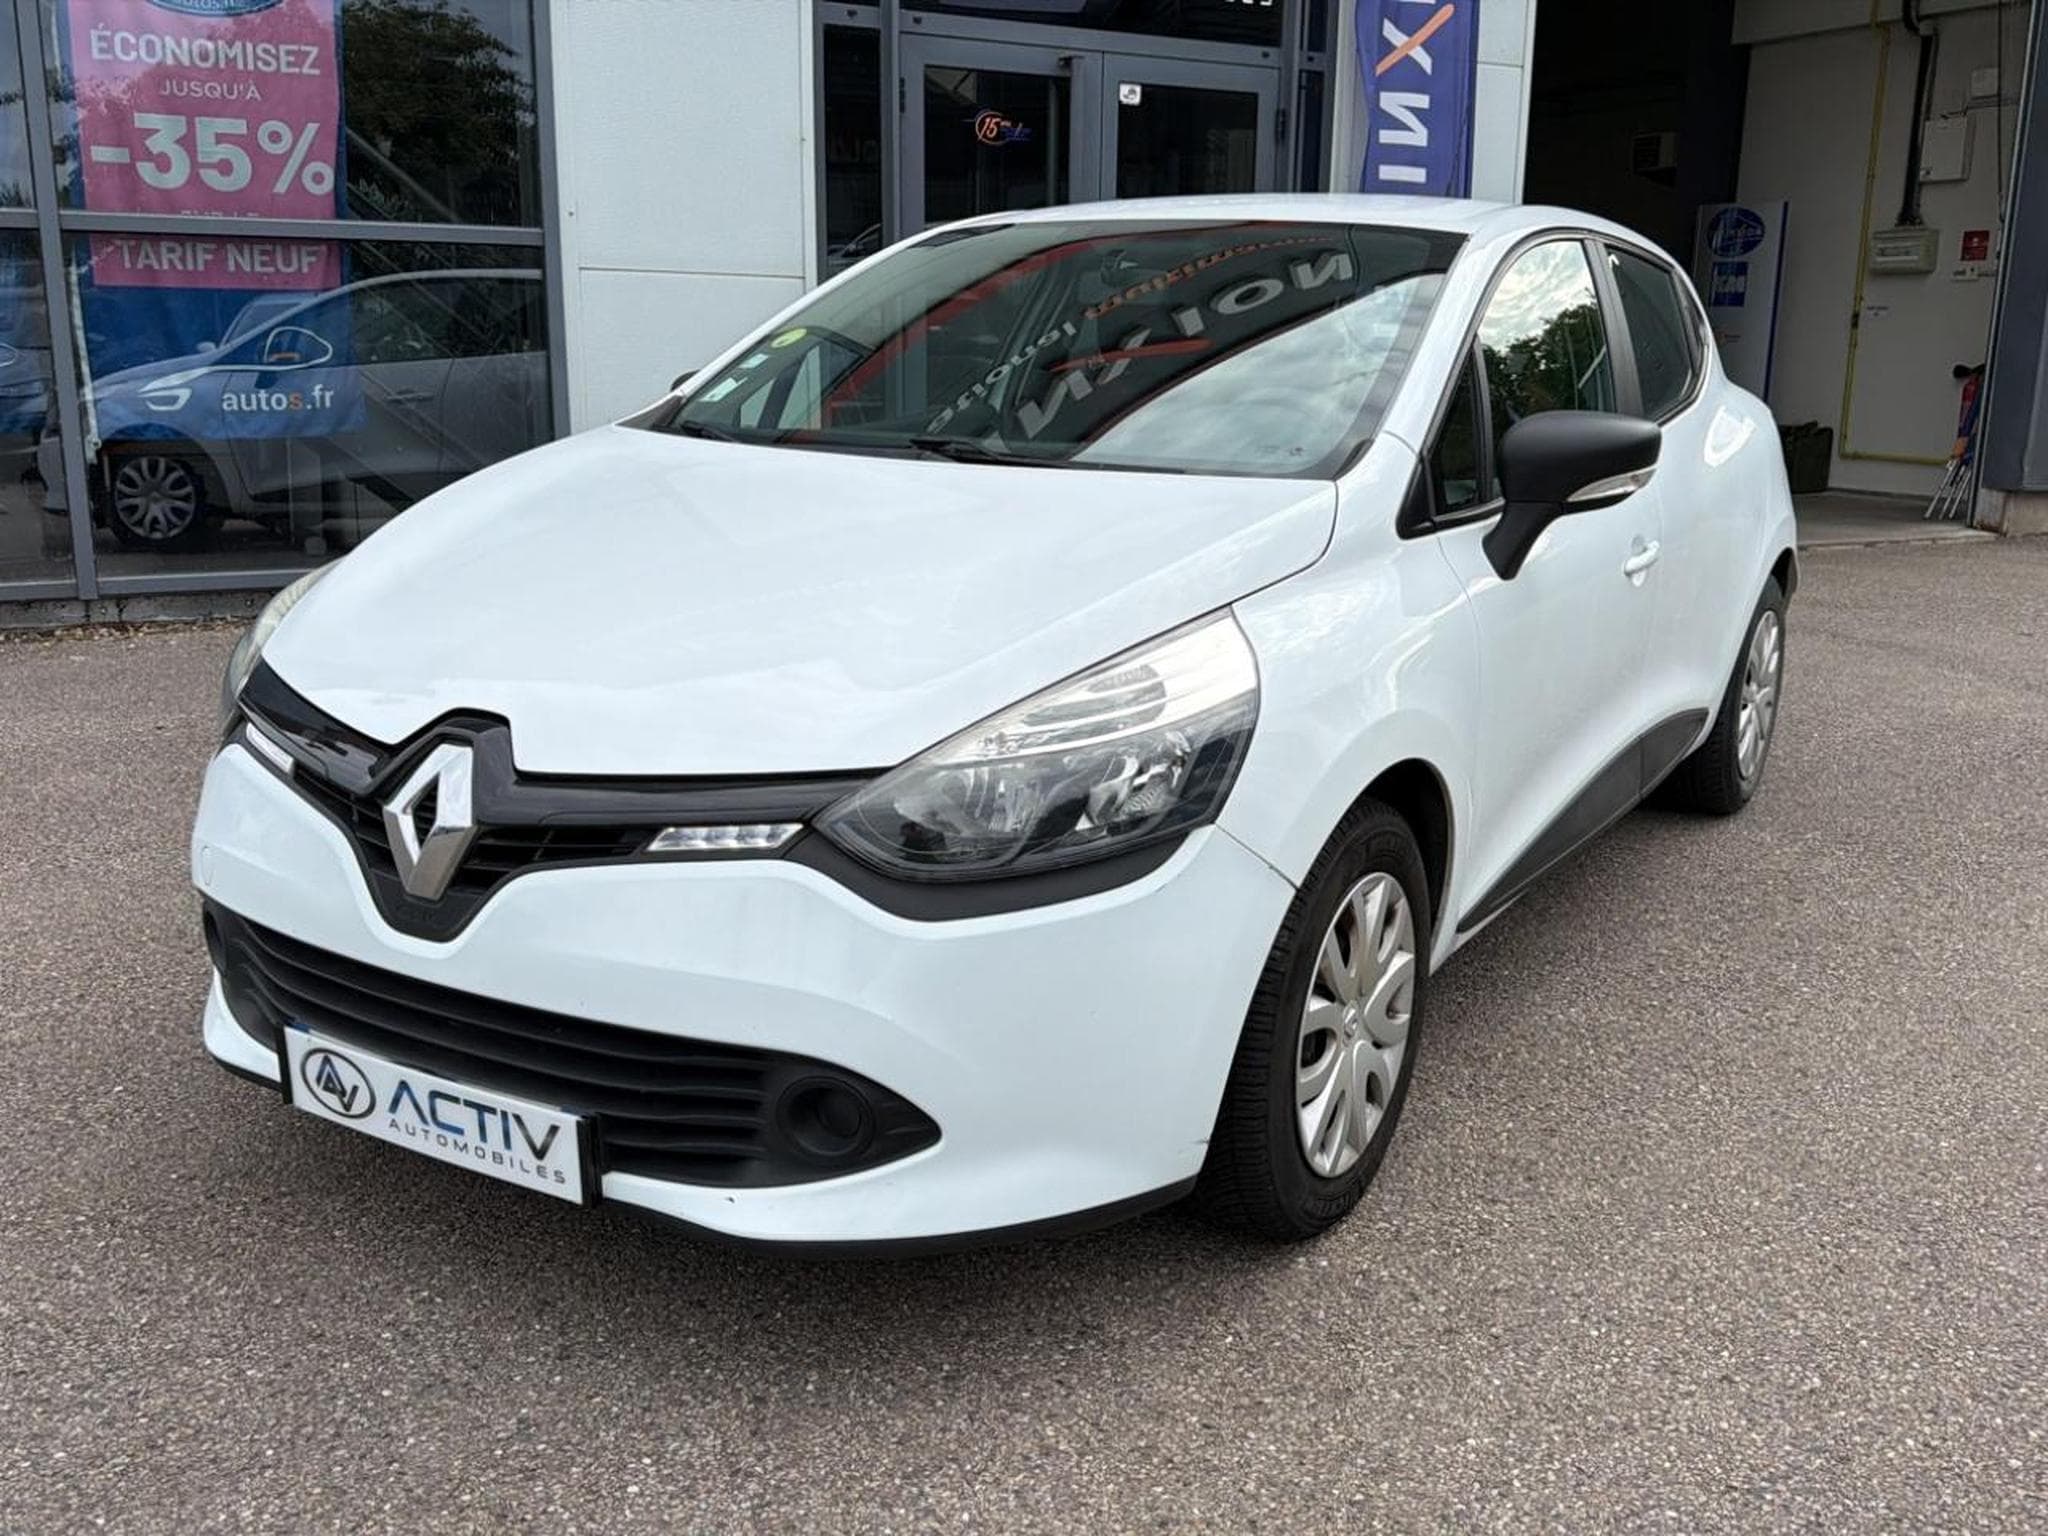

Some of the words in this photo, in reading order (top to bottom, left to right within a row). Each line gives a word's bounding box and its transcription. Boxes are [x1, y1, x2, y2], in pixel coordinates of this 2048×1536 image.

[90, 24, 321, 76] ÉCONOMISEZ
[159, 78, 262, 102] JUSQU'À
[90, 112, 336, 196] -35%
[114, 238, 215, 272] TARIF
[226, 243, 323, 275] NEUF
[221, 384, 335, 413] autos.fr
[388, 1080, 561, 1161] ACTIV
[388, 1118, 567, 1185] AUTOMOBILES
